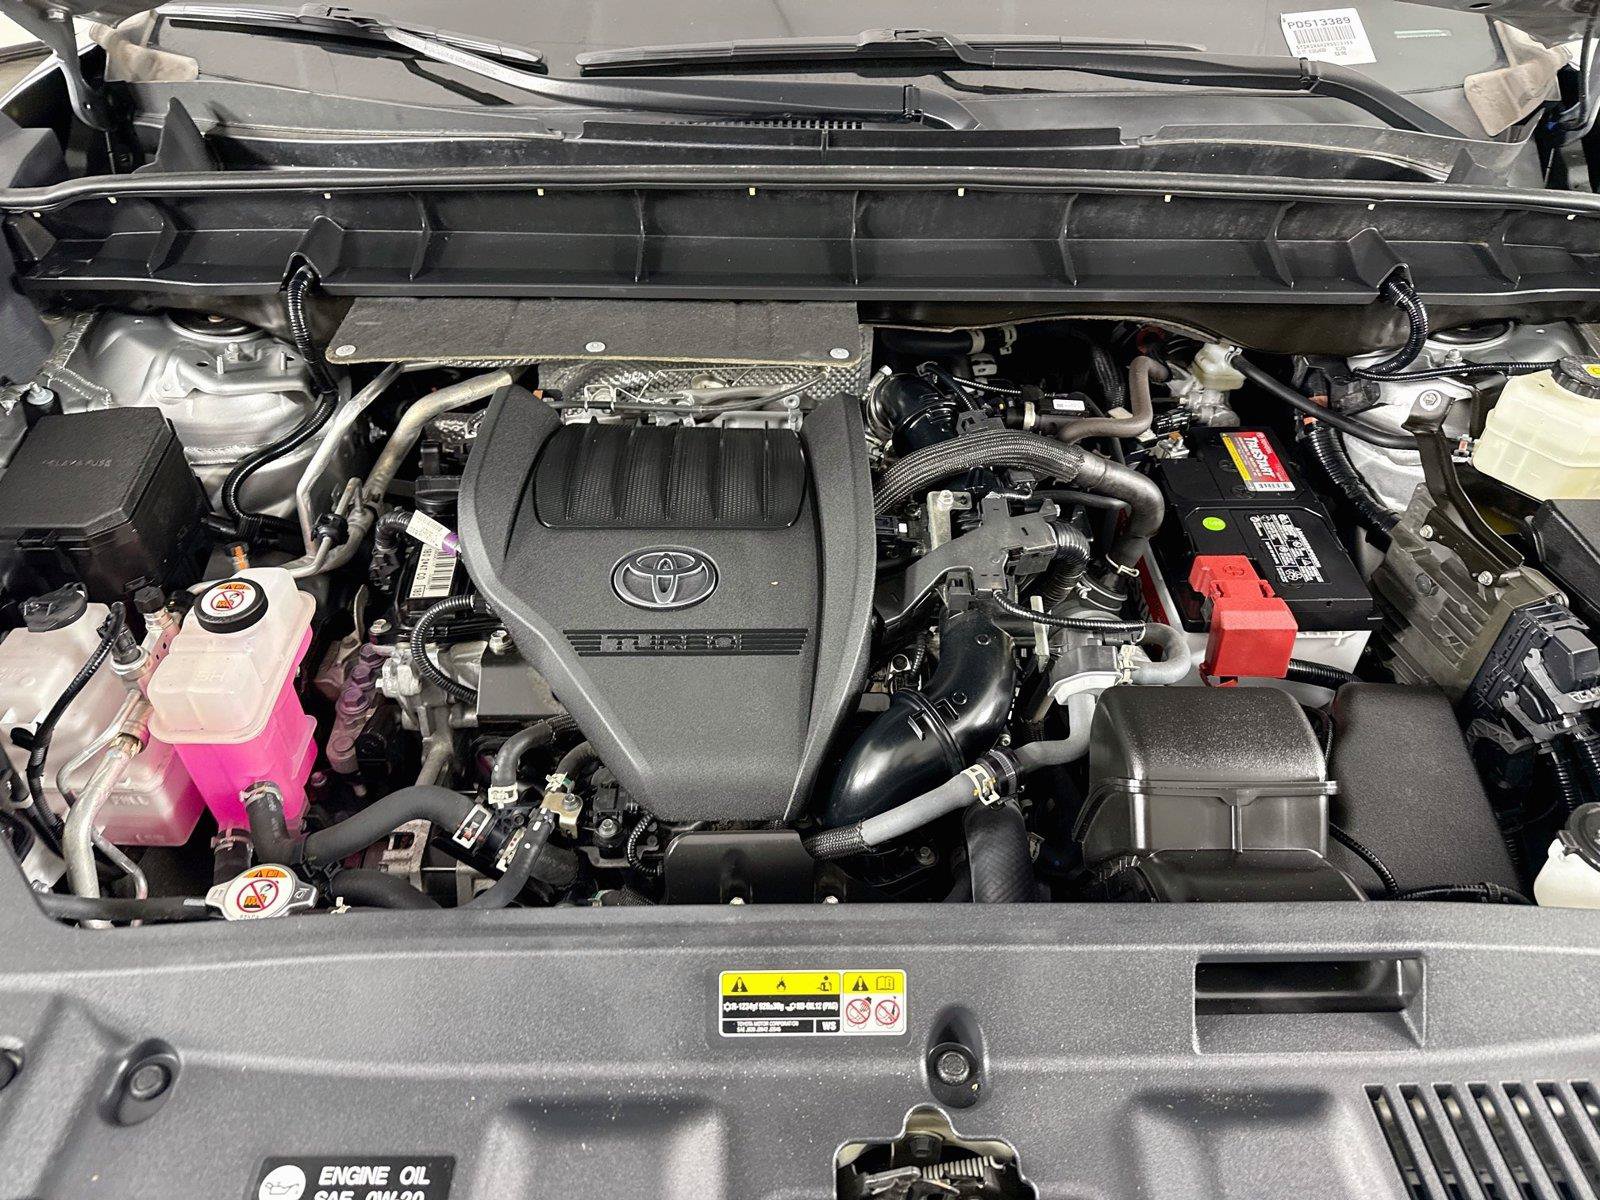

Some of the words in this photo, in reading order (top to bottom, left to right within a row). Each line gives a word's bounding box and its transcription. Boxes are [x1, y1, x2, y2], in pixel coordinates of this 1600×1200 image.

[602, 634, 741, 652] TURO
[318, 1165, 391, 1186] ENGINE
[399, 1165, 431, 1186] OIL
